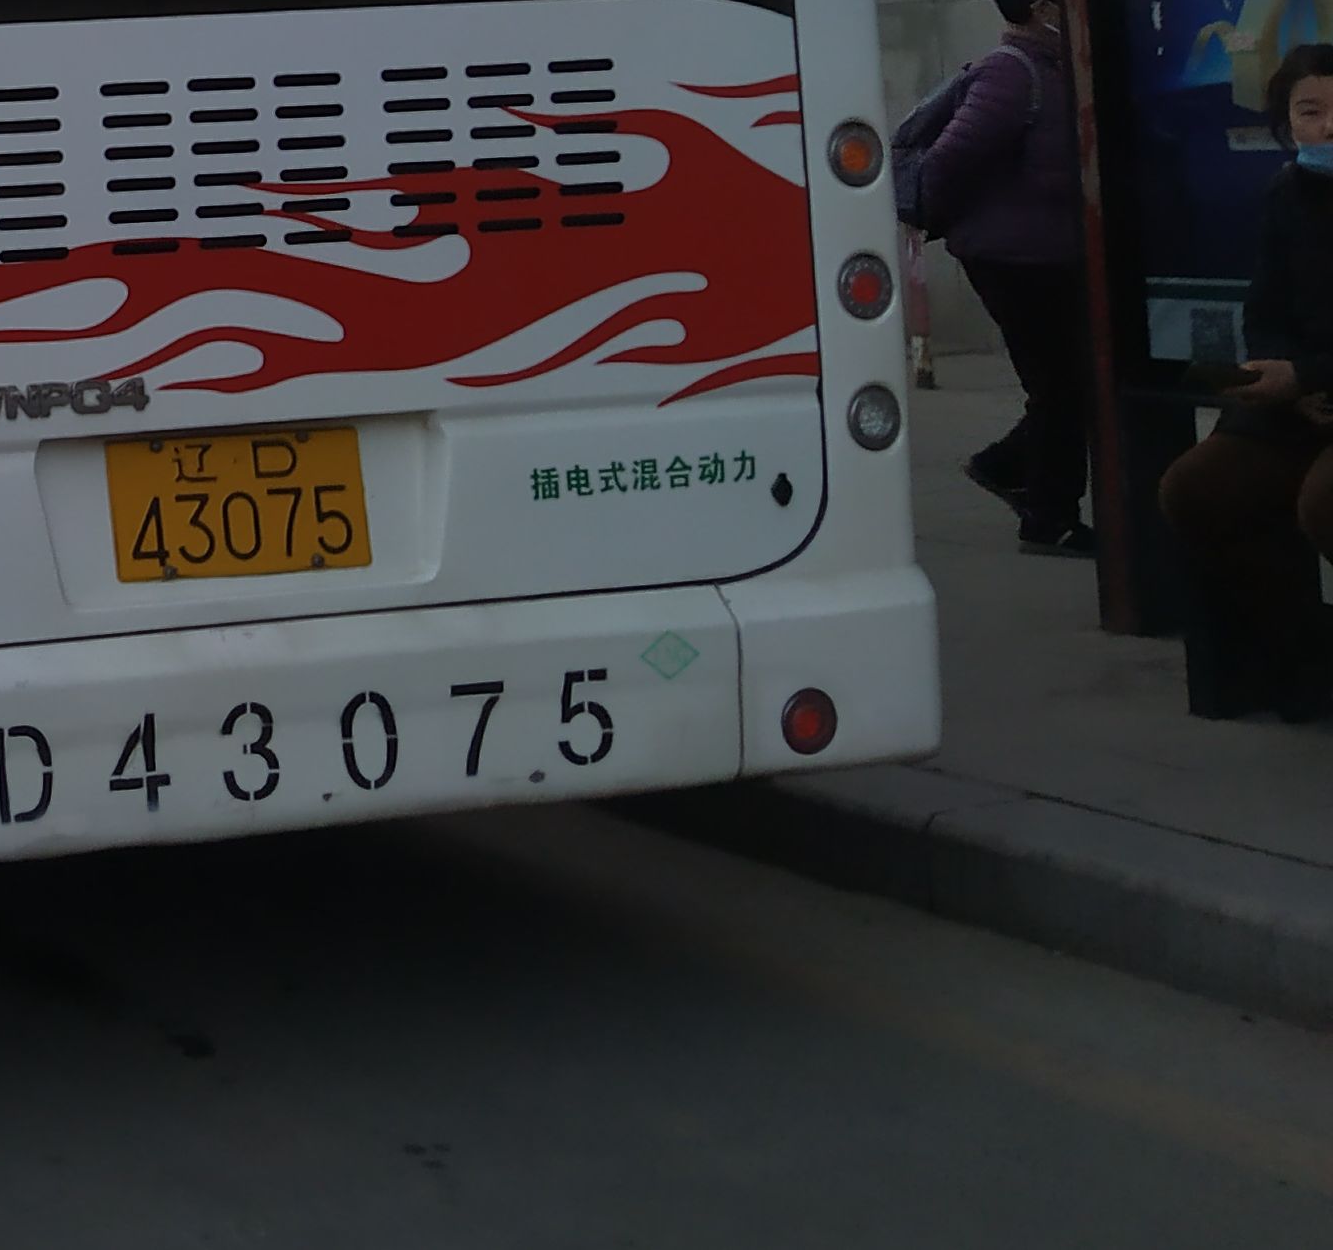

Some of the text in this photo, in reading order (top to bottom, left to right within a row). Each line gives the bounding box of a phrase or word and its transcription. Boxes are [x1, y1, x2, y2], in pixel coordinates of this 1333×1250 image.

[529, 450, 759, 503] 插电式混合动力
[131, 484, 354, 567] 43075
